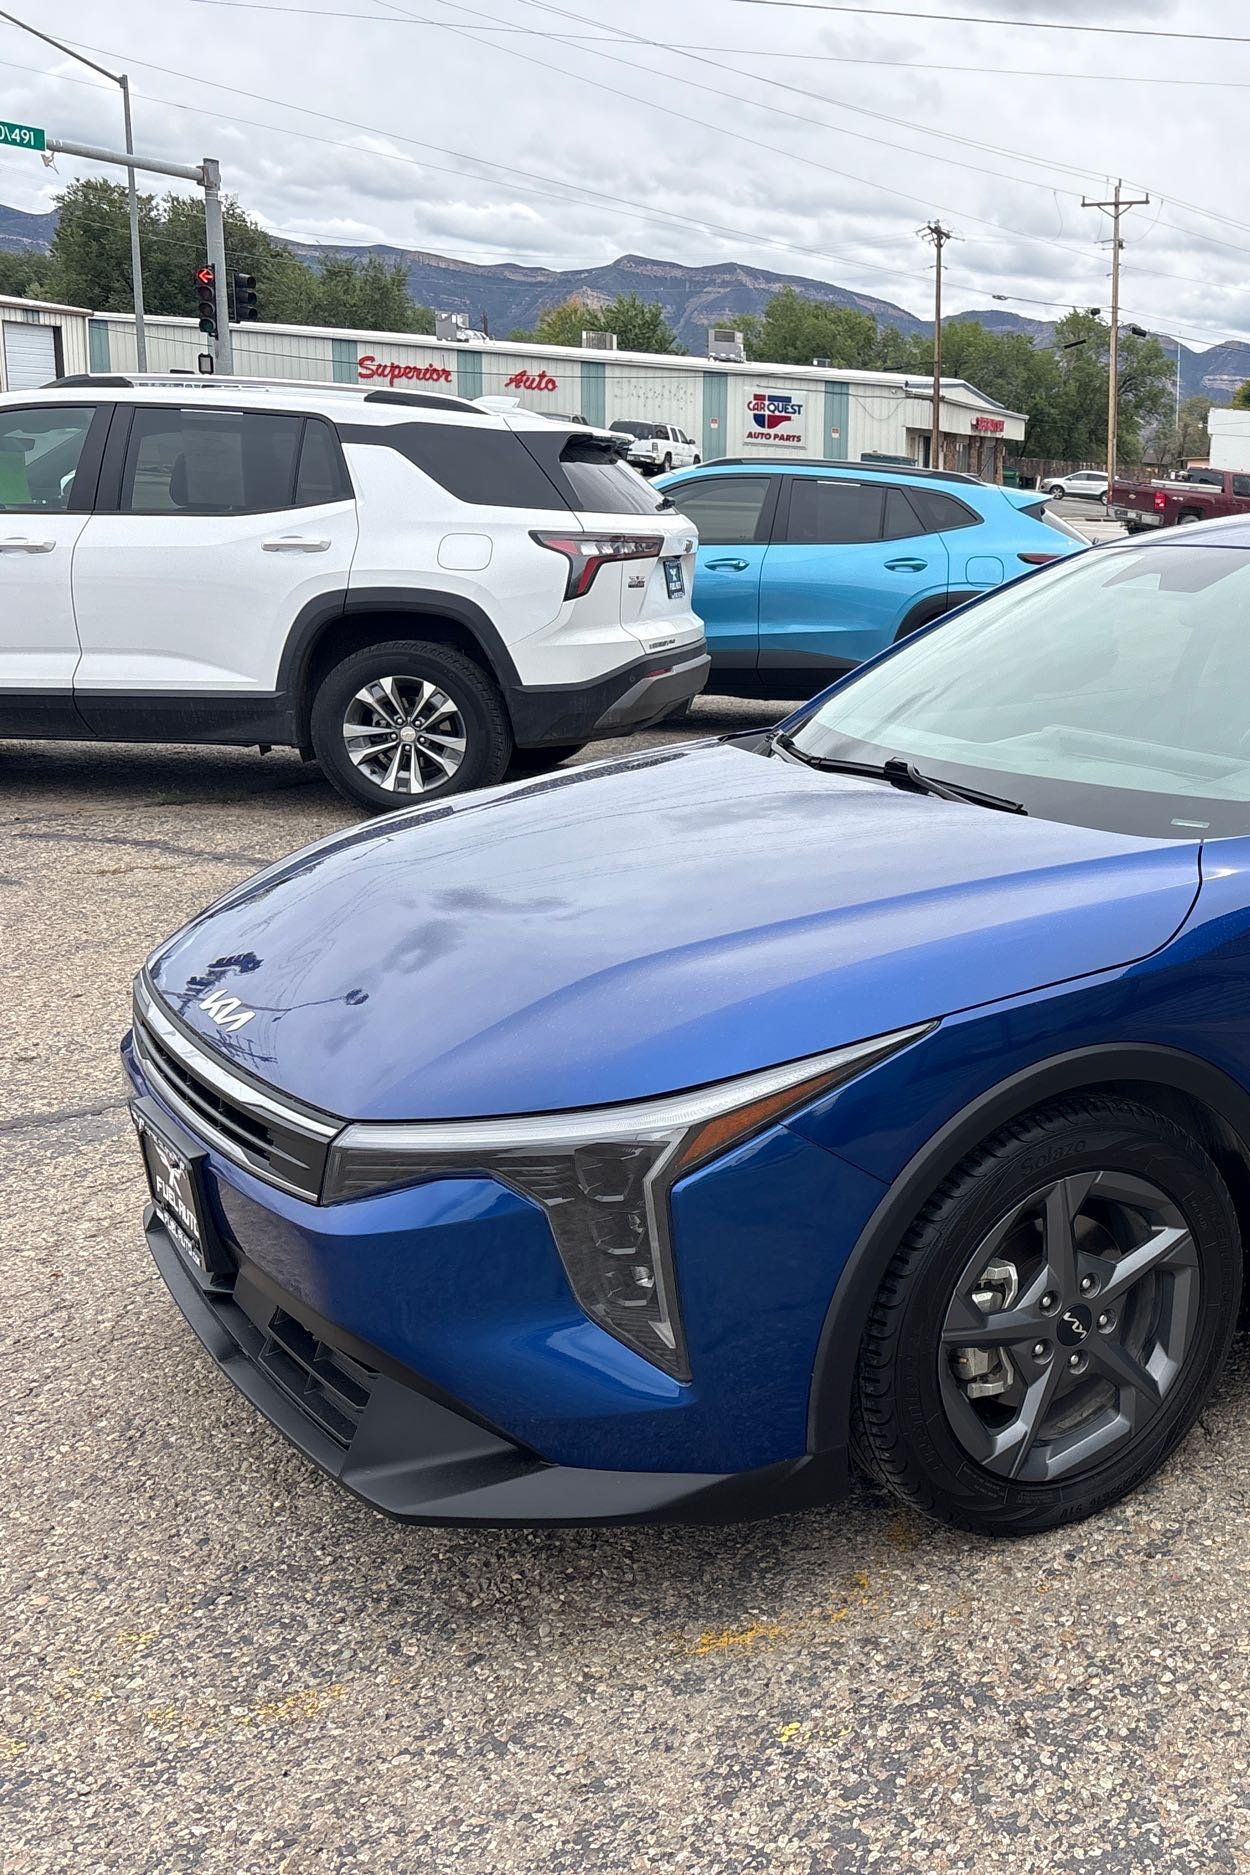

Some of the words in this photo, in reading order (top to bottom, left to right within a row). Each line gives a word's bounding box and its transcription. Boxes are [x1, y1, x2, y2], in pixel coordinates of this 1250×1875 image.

[358, 356, 453, 387] Superior
[504, 370, 558, 392] Auto
[746, 431, 772, 441] AUTO
[772, 432, 802, 443] PARTS
